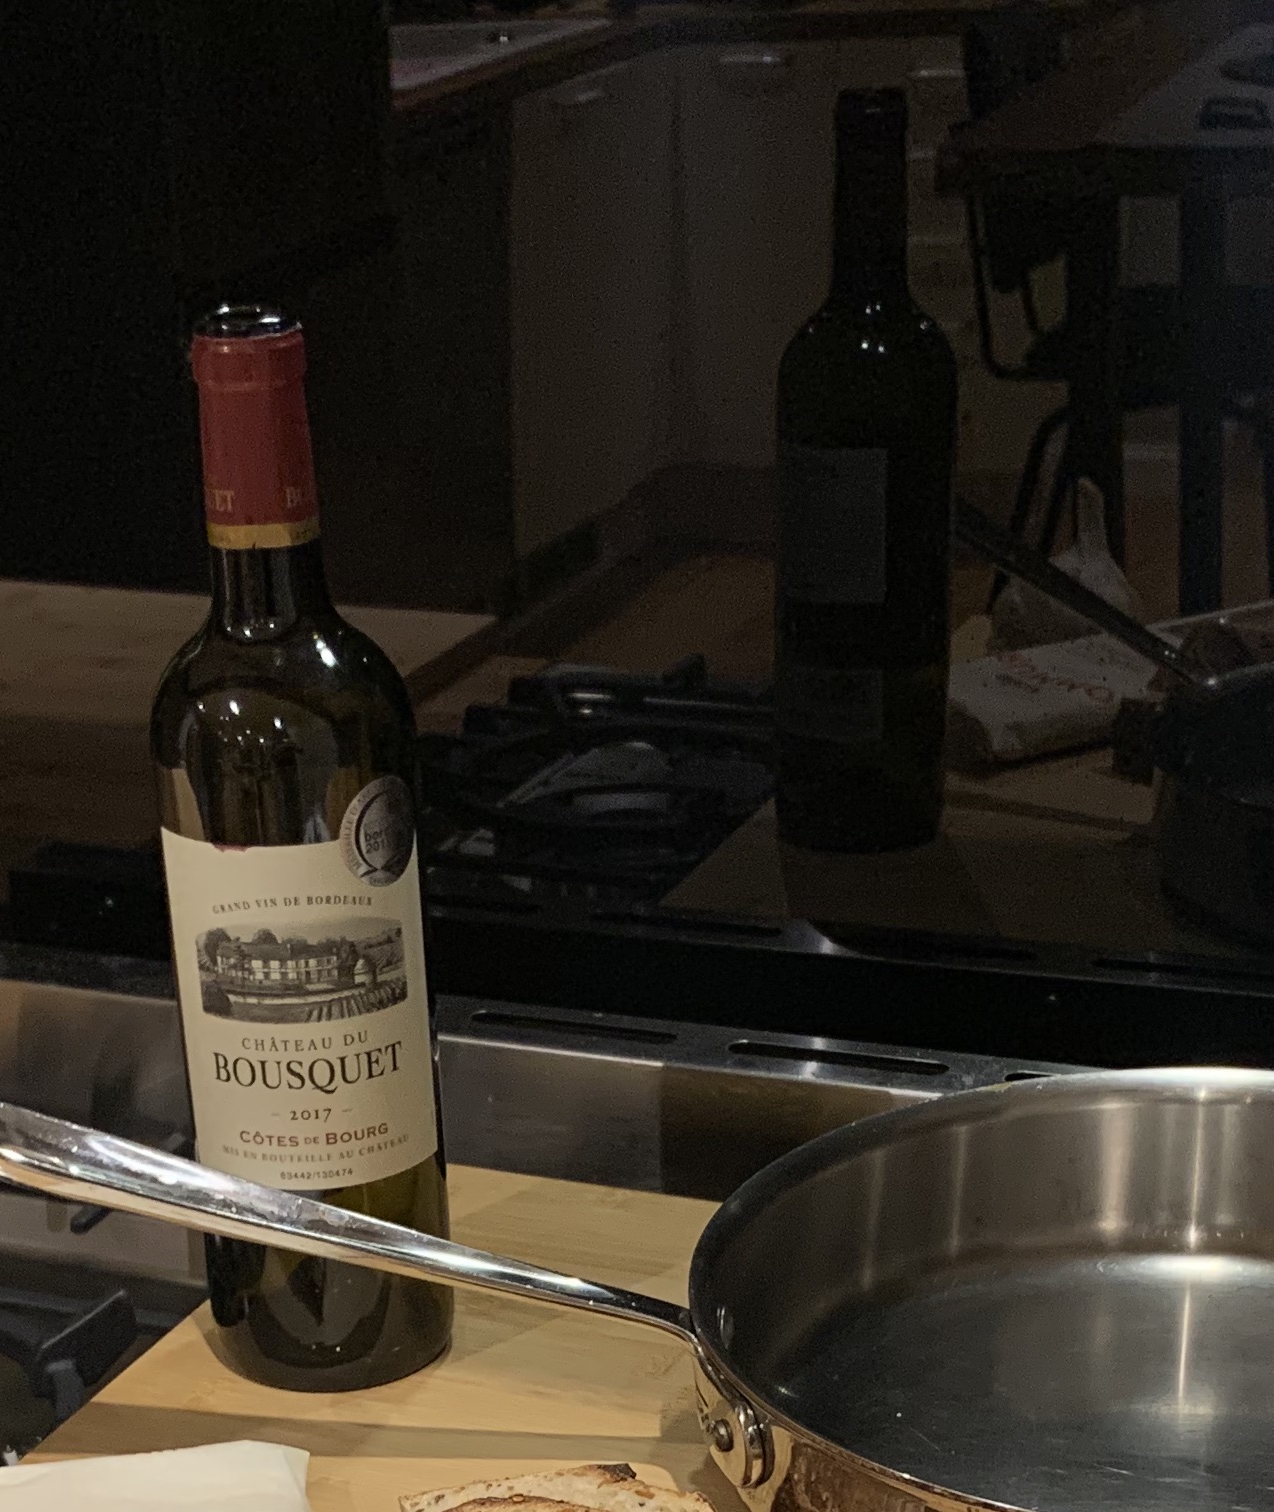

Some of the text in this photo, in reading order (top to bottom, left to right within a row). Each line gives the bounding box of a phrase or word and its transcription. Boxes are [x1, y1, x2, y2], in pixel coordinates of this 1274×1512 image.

[212, 895, 373, 914] GRAND VIN DE BORDEAUX
[241, 1030, 369, 1052] CHÂTEAU DU
[212, 1040, 403, 1095] BOUSQUET
[289, 1108, 333, 1123] 2017
[239, 1122, 390, 1147] CÔTES DE BOURG
